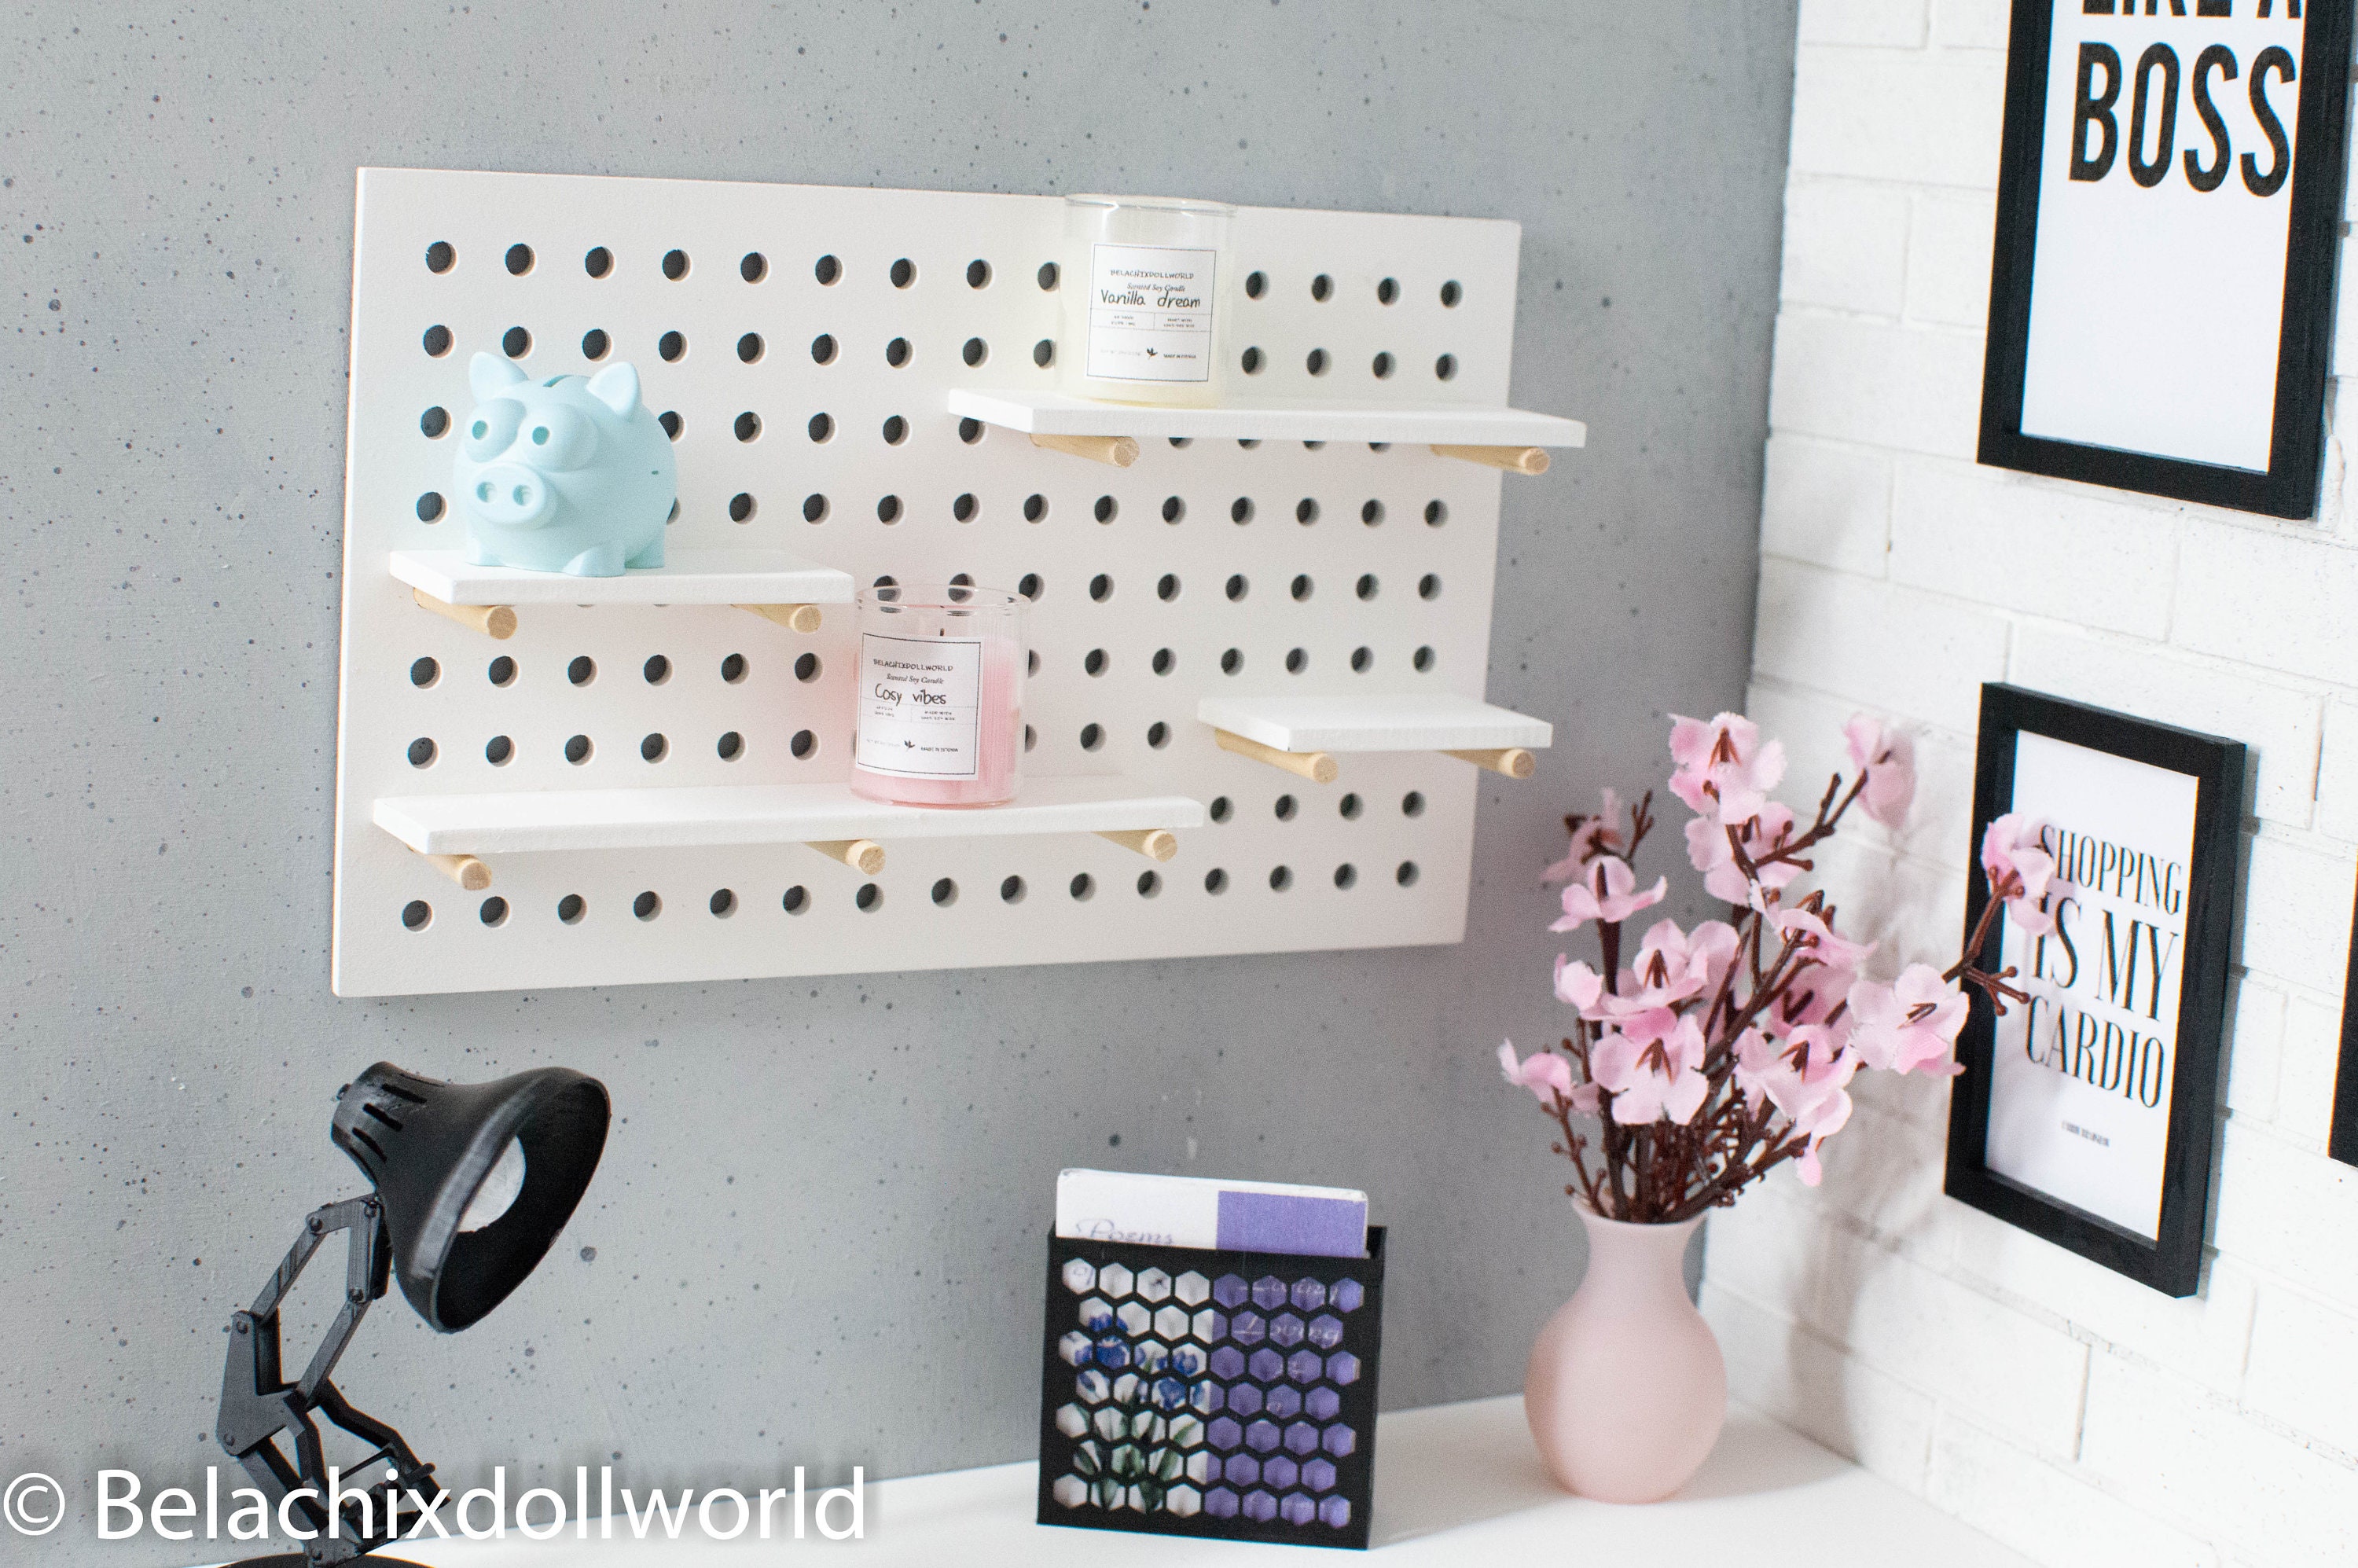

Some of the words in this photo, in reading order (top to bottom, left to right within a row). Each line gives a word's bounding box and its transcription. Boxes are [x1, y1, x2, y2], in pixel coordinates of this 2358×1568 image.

[2069, 42, 2296, 197] BOSS
[1110, 270, 1194, 280] BELACHIXDOLLWORLD
[1100, 289, 1145, 306] Vanilla
[1157, 290, 1200, 308] dream
[873, 659, 953, 671] BELACHIXDOLLWORLD
[875, 683, 902, 706] Cosy
[913, 689, 946, 704] vibes
[2032, 891, 2081, 989] IS
[2094, 909, 2180, 1023] MY
[2025, 995, 2165, 1108] CARDIO
[1075, 1218, 1173, 1245] Poems
